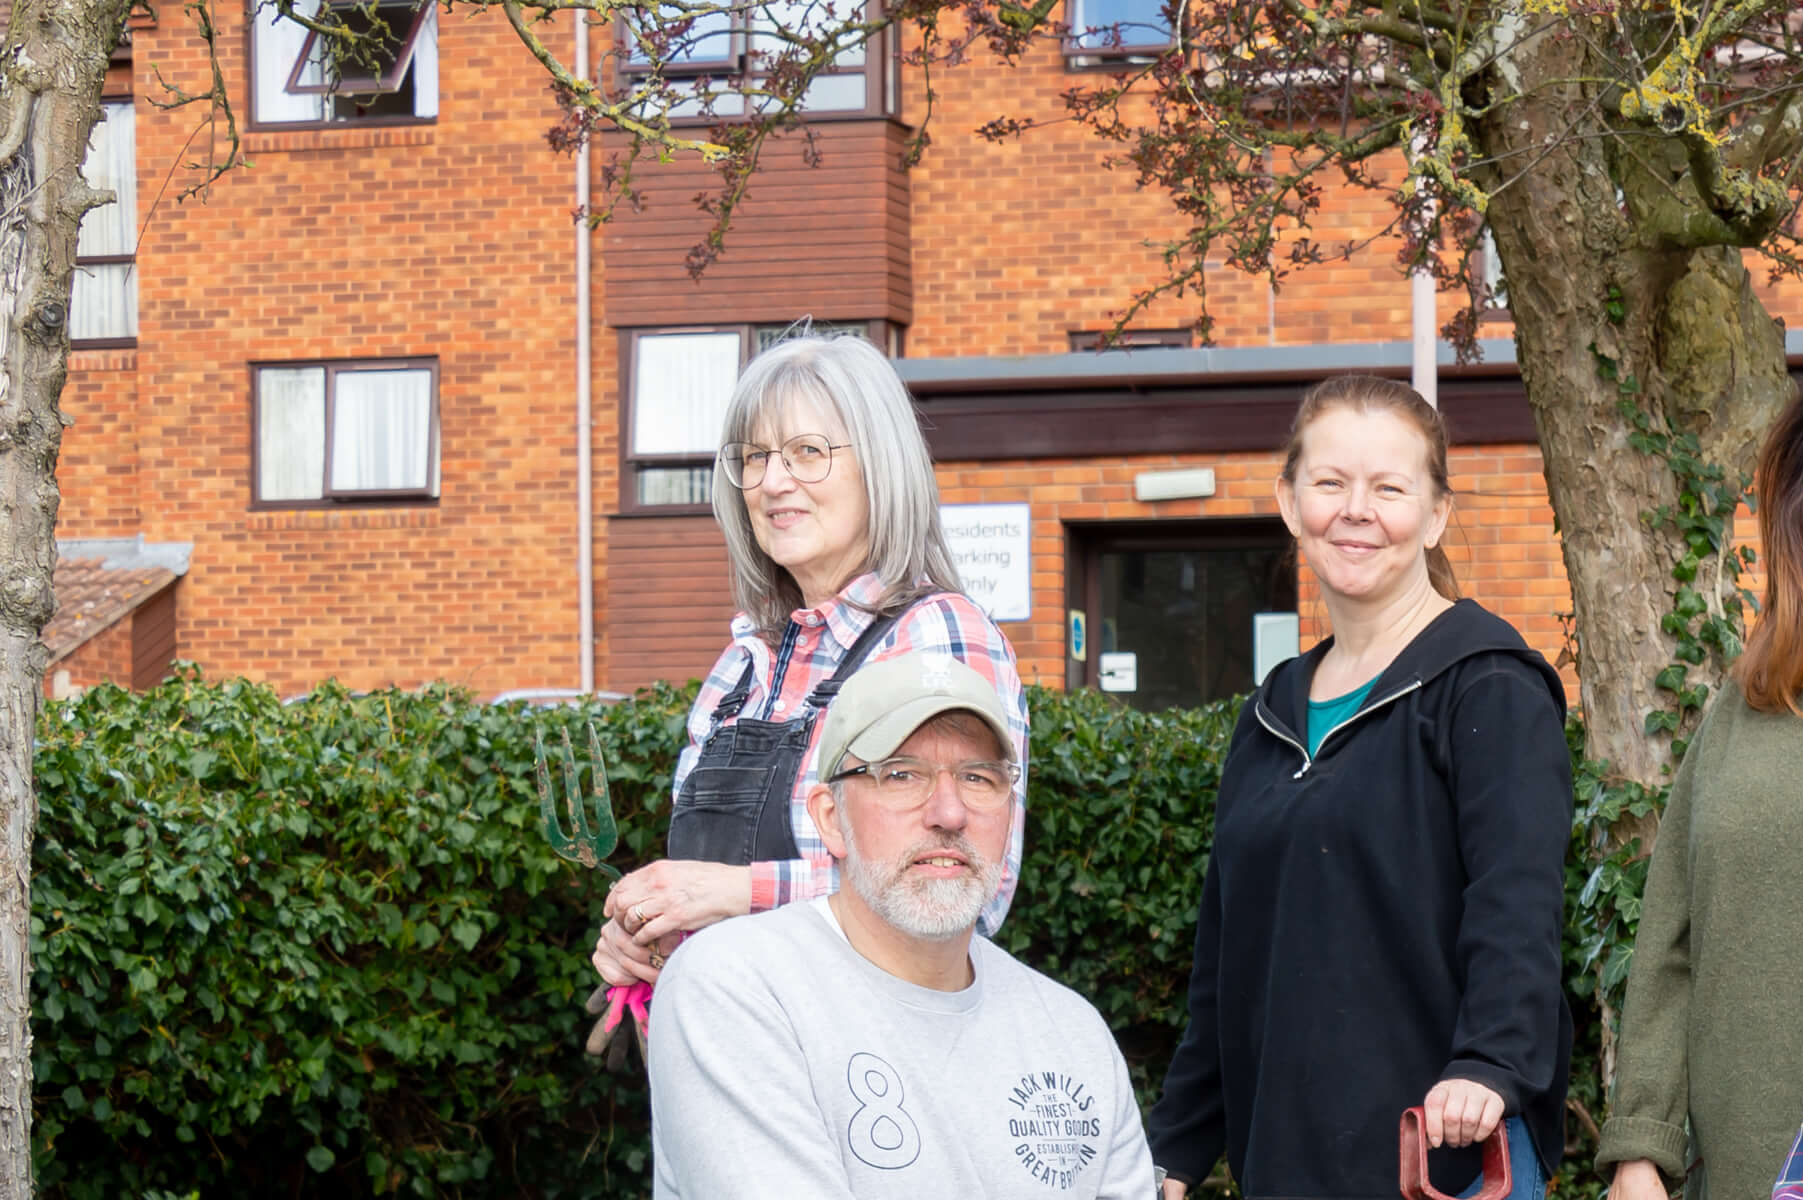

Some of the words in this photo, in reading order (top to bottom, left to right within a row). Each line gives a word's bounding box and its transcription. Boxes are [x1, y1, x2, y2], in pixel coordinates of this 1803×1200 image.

[943, 522, 1021, 539] esidents
[952, 546, 1011, 568] arking
[1008, 1073, 1042, 1111] JACK
[1042, 1071, 1095, 1111] WILLS
[1043, 1094, 1057, 1103] THE
[847, 1051, 921, 1170] 8
[1036, 1103, 1072, 1118] FINEST
[1009, 1119, 1060, 1137] QUALITY
[1015, 1143, 1058, 1188] GREAT
